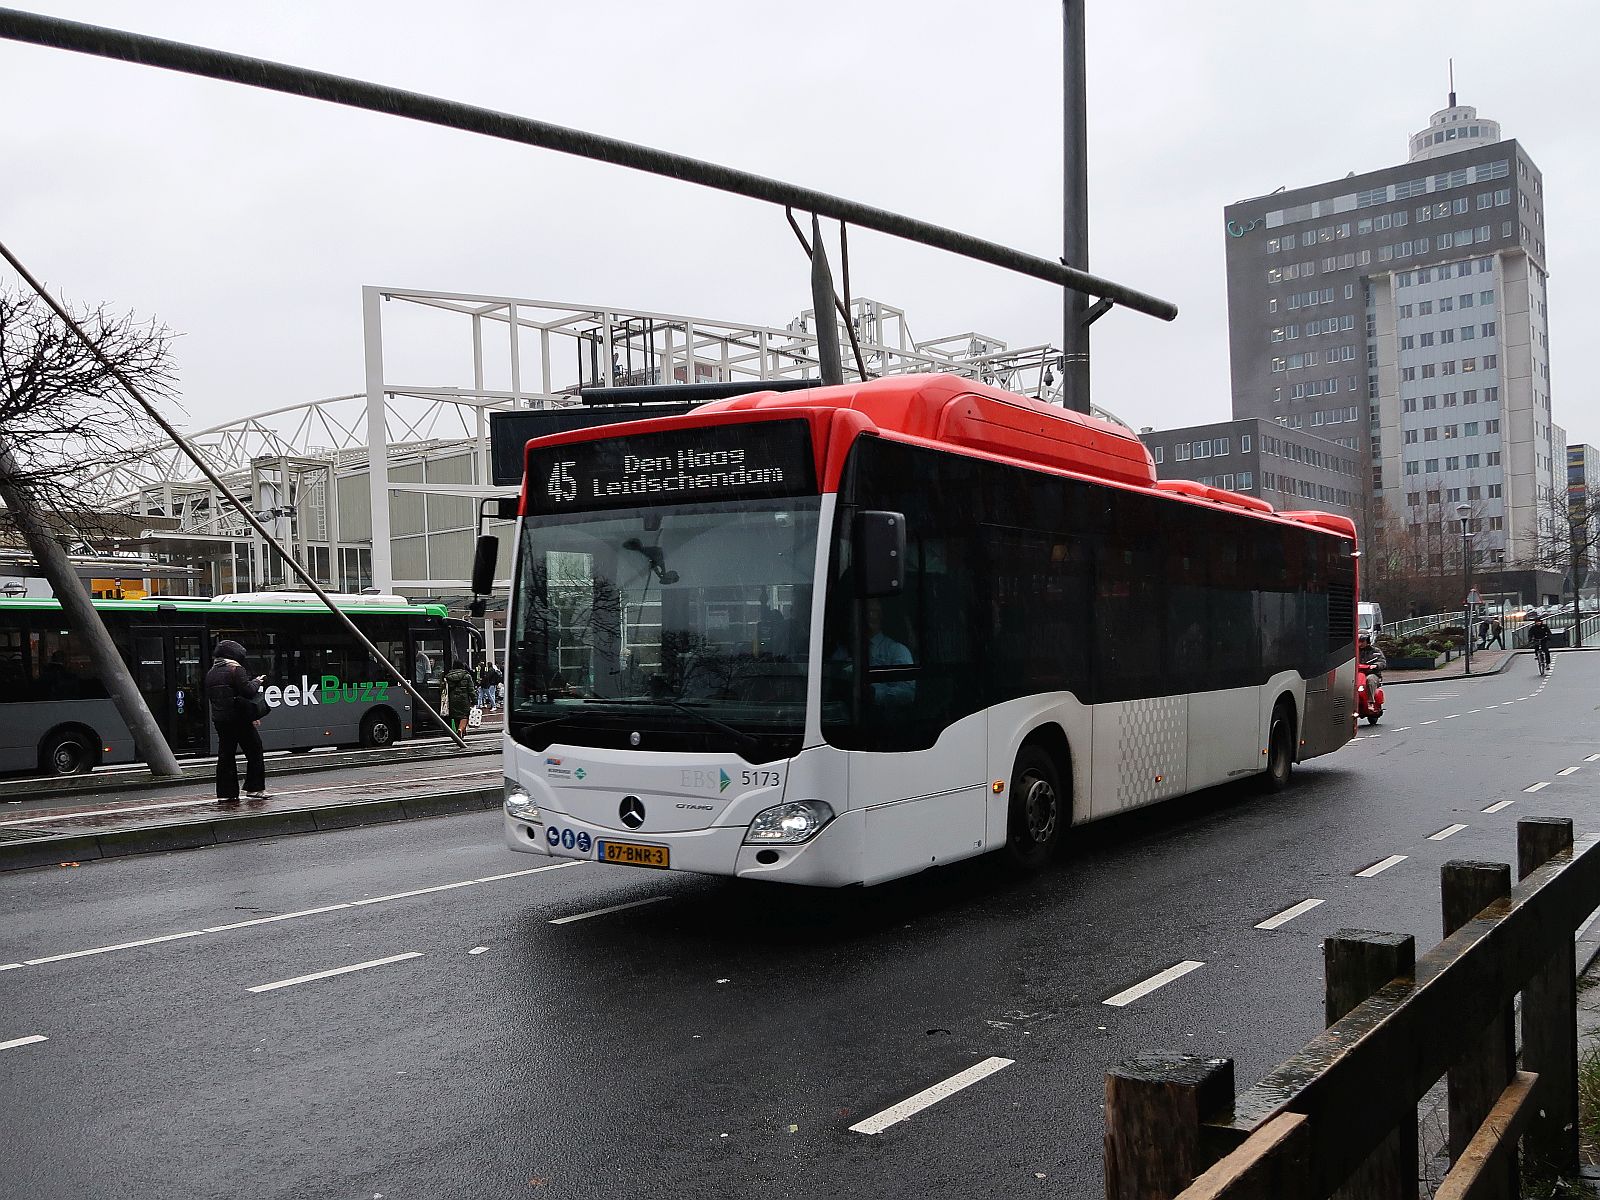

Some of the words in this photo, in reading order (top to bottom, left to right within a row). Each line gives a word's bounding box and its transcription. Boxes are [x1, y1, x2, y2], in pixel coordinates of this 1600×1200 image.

[624, 455, 671, 473] Den
[678, 450, 745, 468] Haag
[547, 462, 577, 501] 45
[593, 466, 783, 497] Leidschendam
[258, 675, 389, 708] eekBuzz
[680, 769, 716, 789] EBS
[741, 771, 780, 787] 5173
[608, 845, 663, 864] 87-BNR-3
